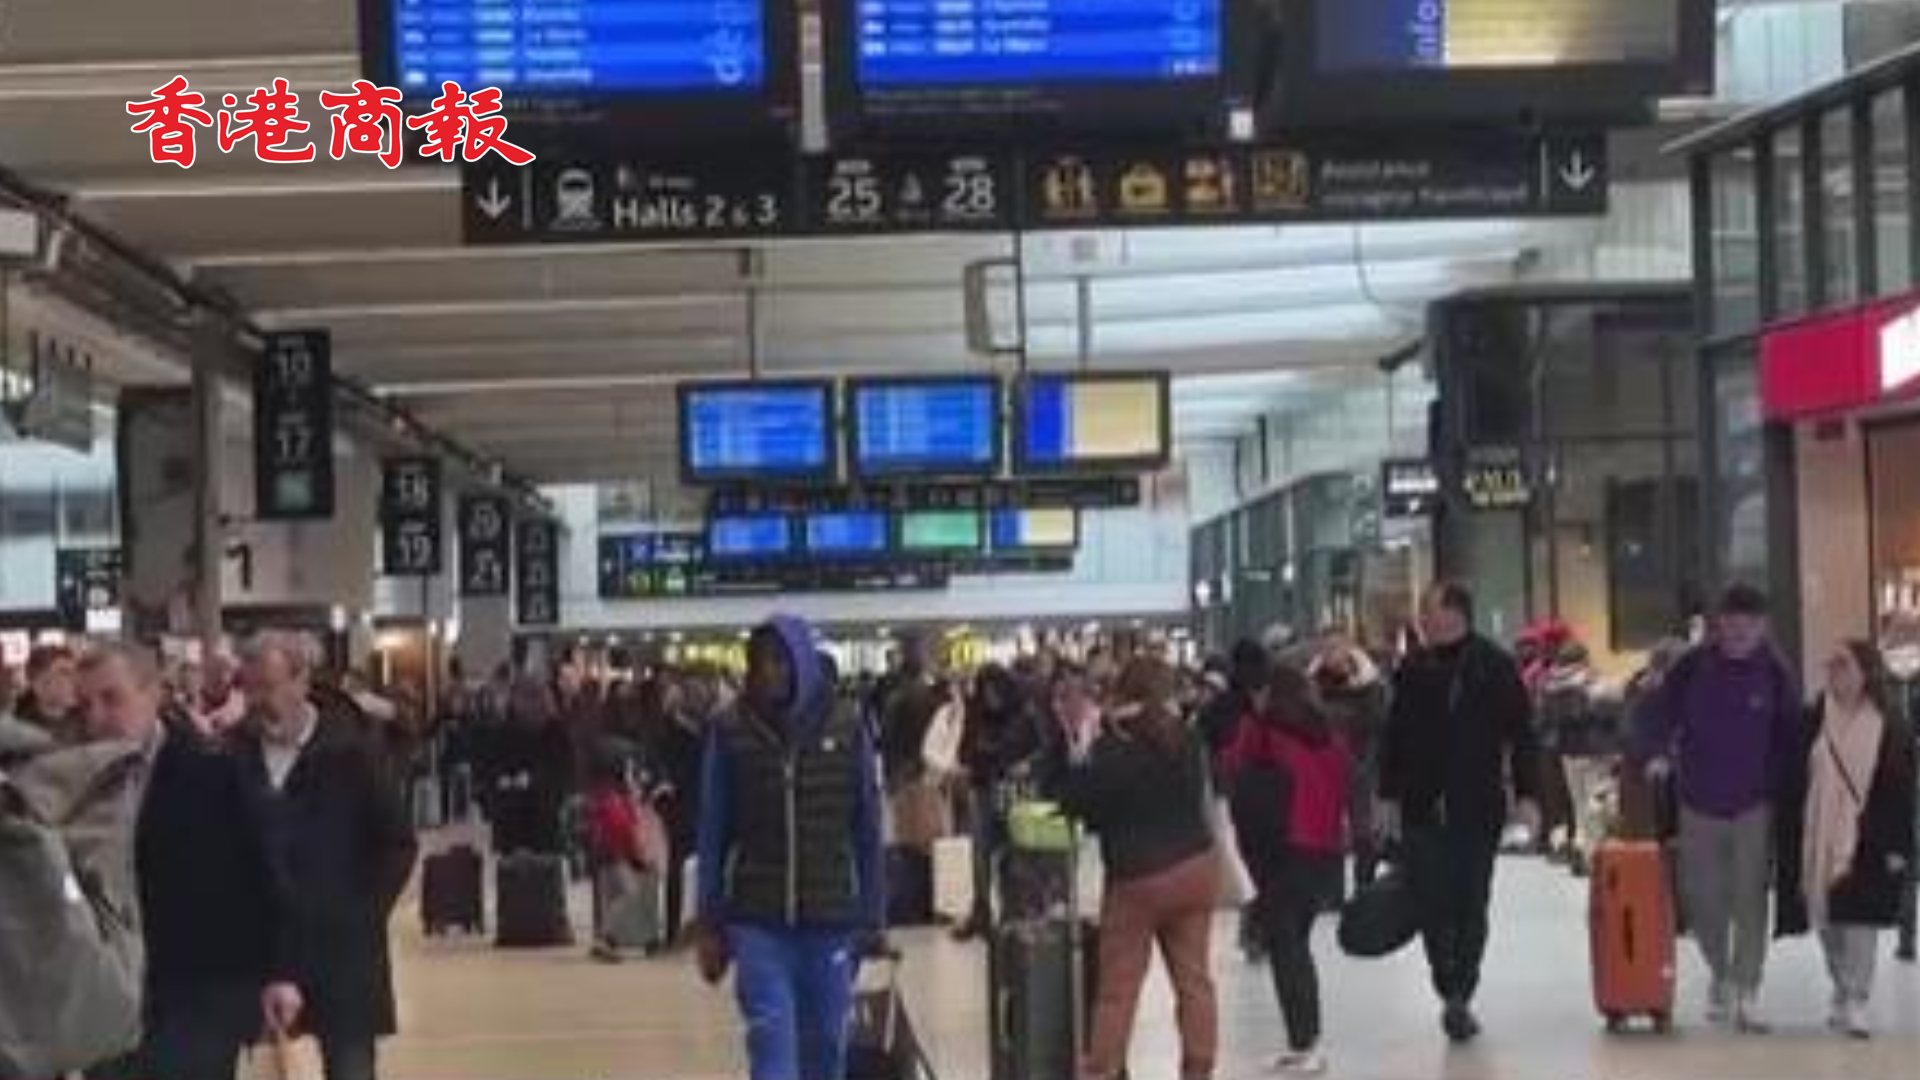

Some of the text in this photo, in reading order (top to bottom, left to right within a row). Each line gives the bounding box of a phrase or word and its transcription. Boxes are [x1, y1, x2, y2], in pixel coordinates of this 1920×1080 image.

[612, 196, 697, 229] Halls
[705, 194, 727, 229] 2
[756, 193, 778, 225] 3
[827, 176, 883, 219] 25
[943, 174, 996, 218] 28
[273, 427, 313, 462] 17
[225, 543, 253, 592] 1
